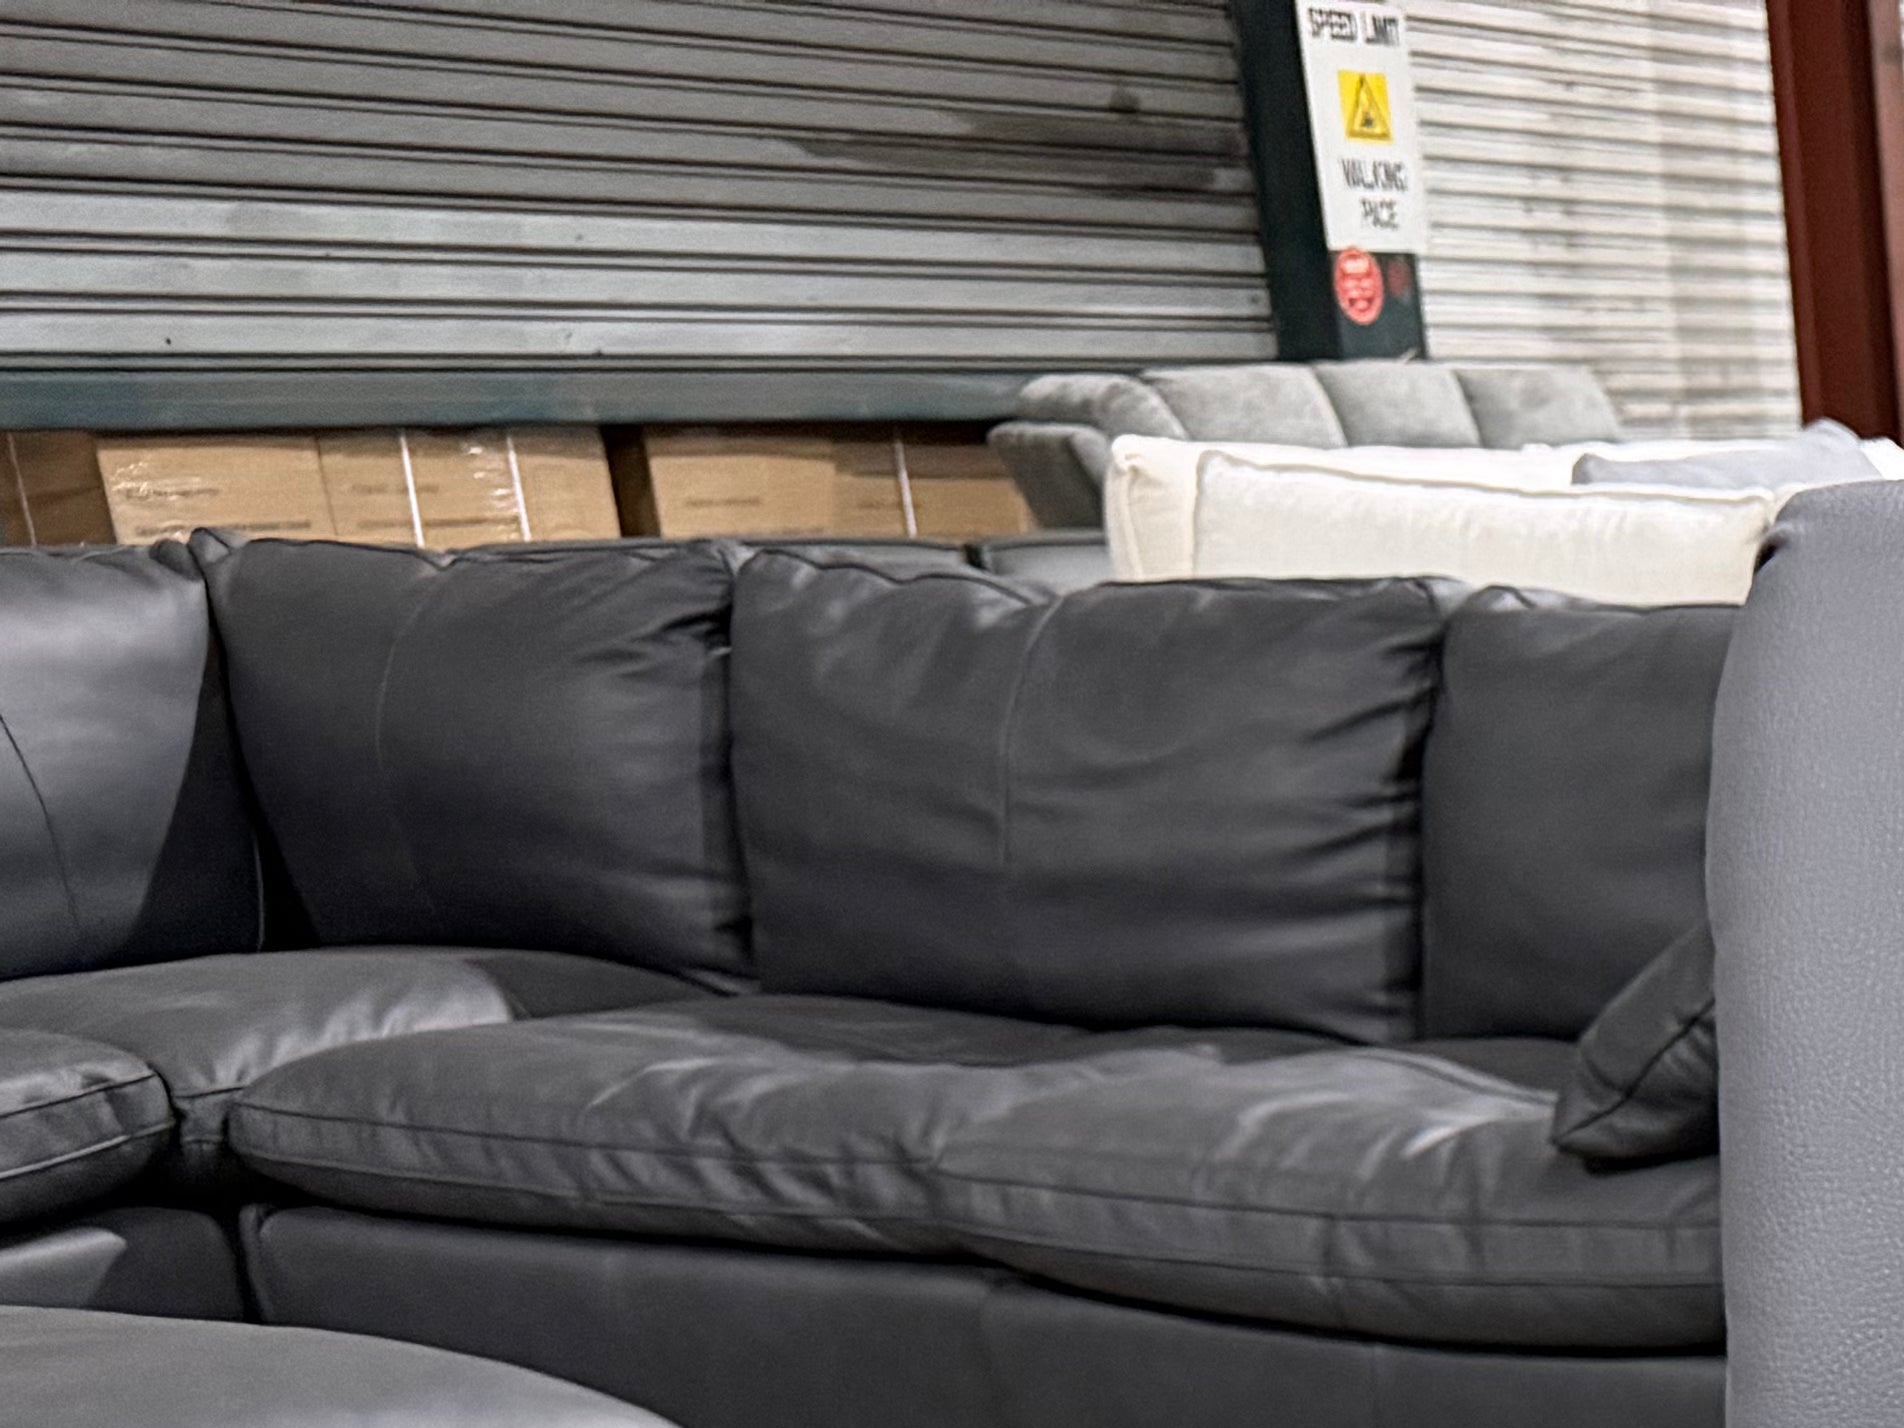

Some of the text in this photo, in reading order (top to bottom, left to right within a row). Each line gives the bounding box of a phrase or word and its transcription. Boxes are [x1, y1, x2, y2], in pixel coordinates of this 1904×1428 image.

[1308, 8, 1400, 45] SPEED LIMIT
[1341, 158, 1408, 191] WALKING
[1361, 198, 1398, 231] PACE
